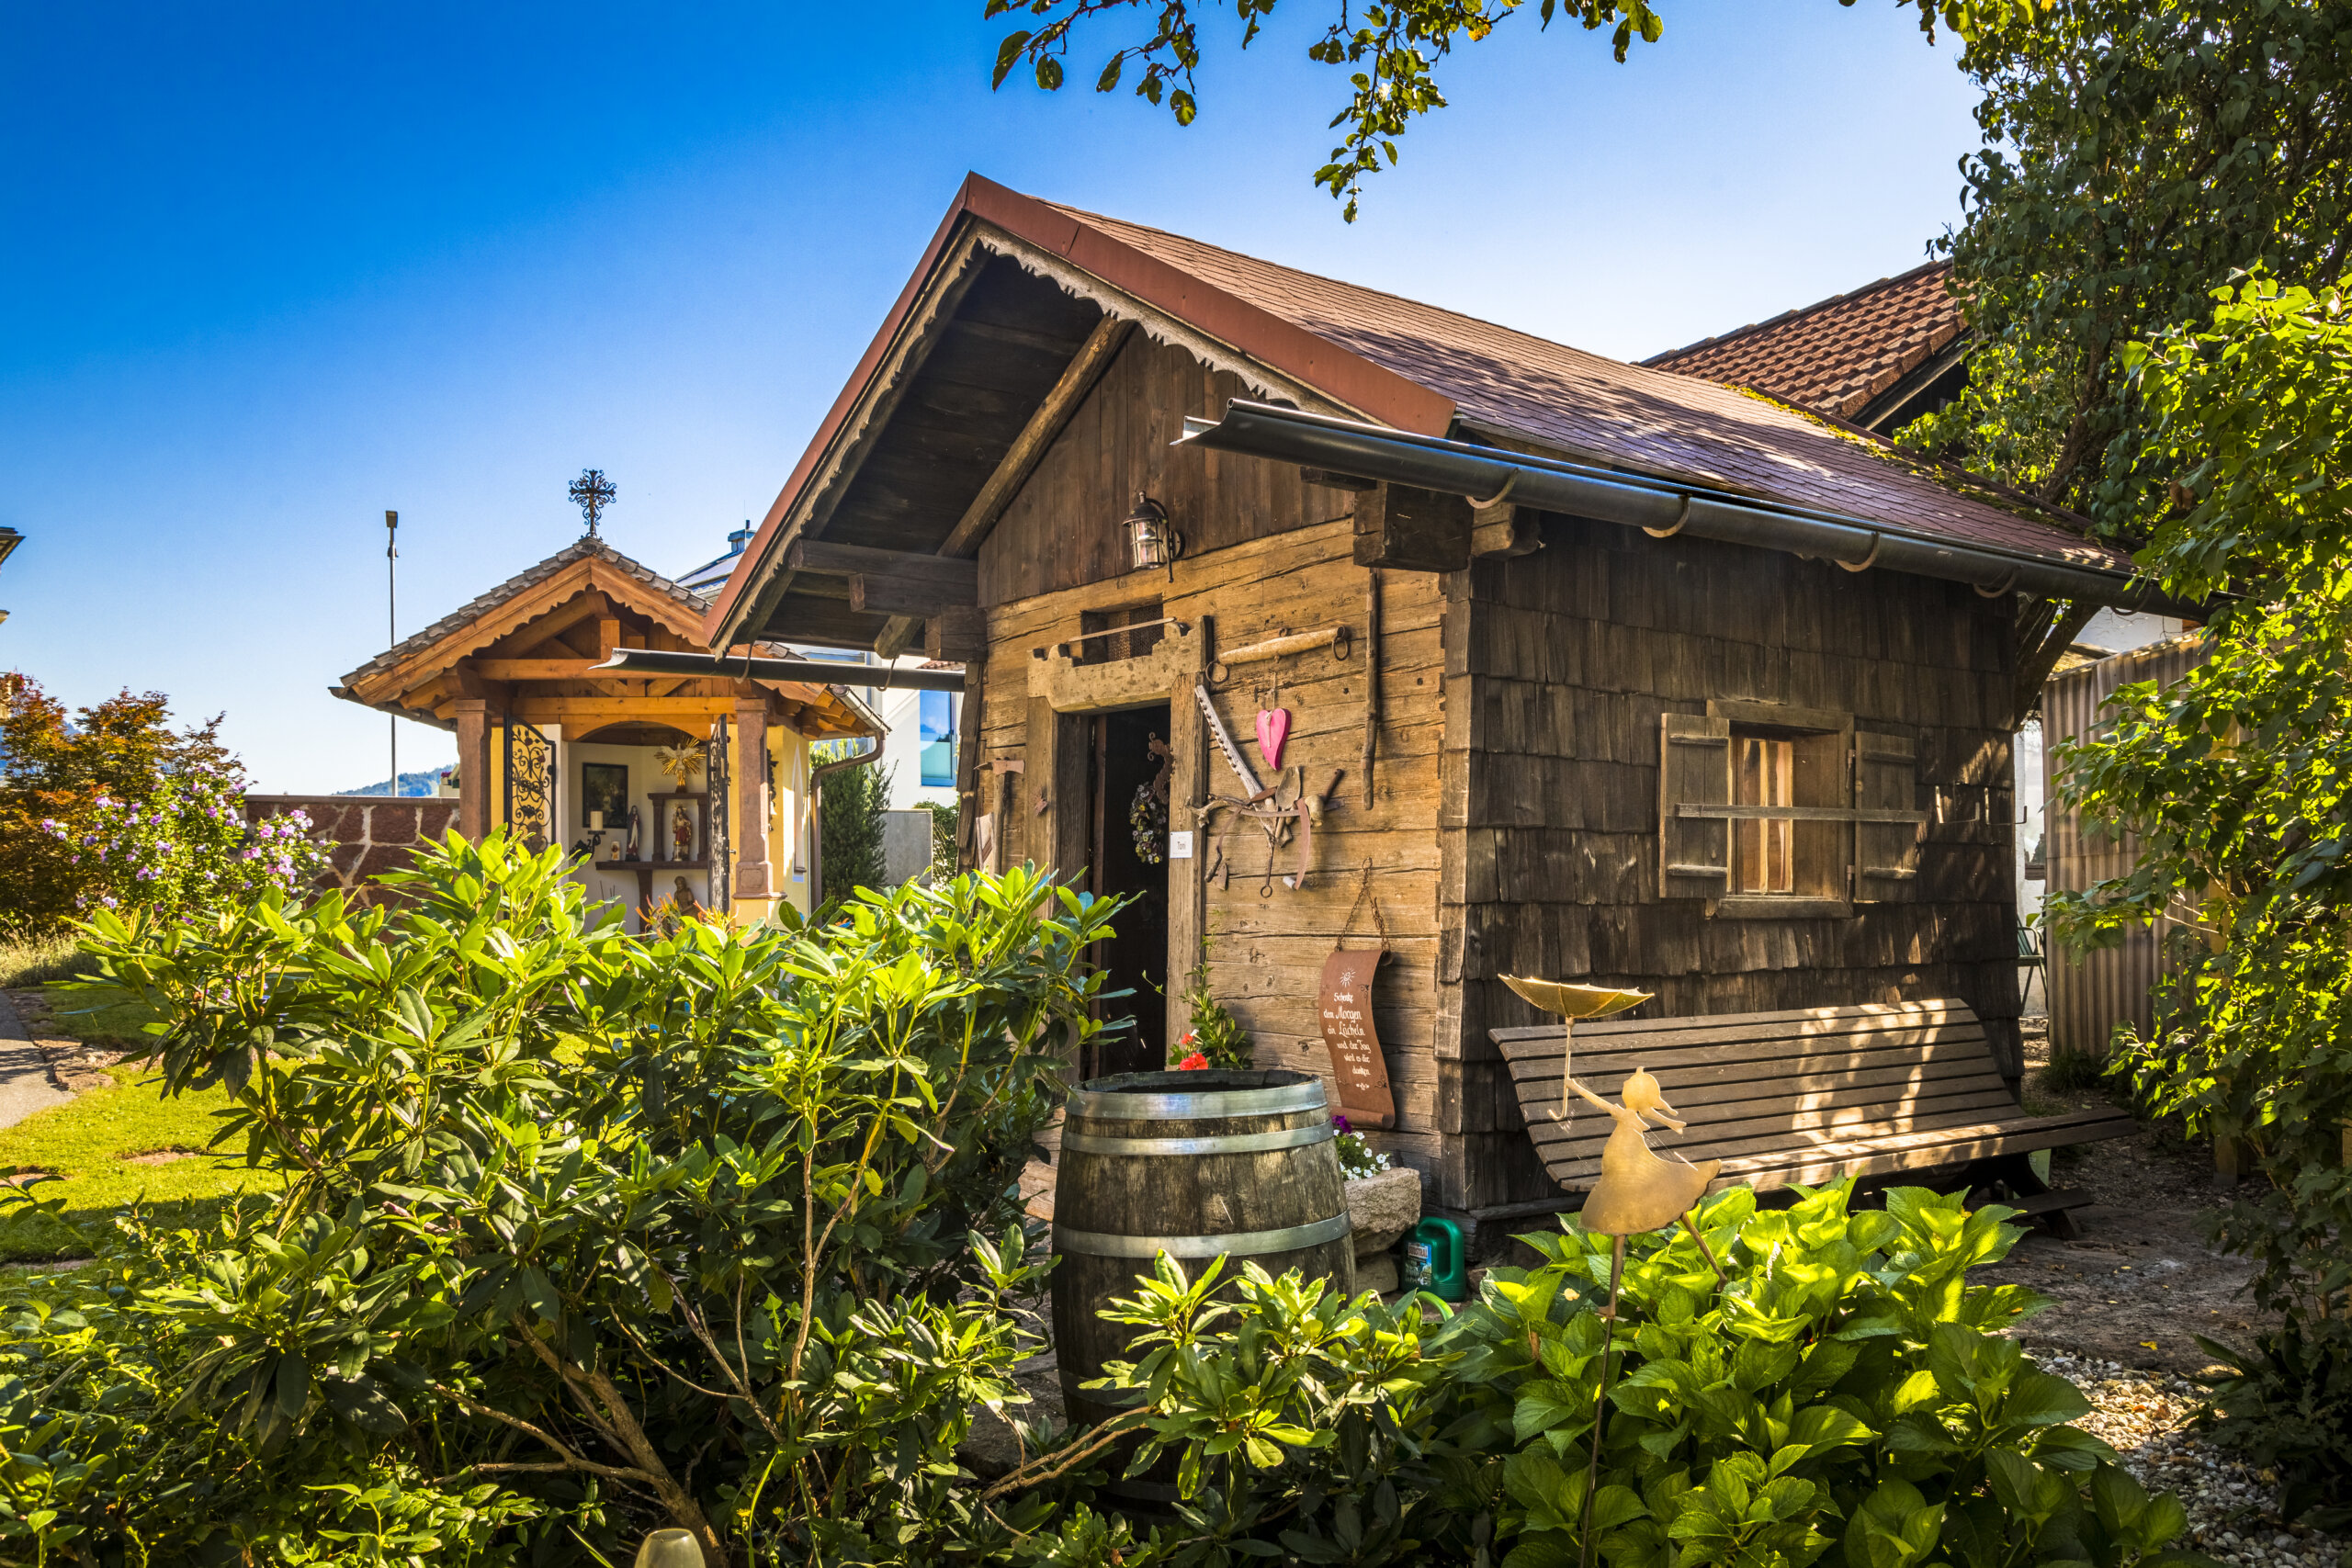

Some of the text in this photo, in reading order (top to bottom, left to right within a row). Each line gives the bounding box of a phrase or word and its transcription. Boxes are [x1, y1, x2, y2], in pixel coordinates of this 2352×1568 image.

[1334, 992, 1353, 1003] Schenke
[1324, 1006, 1363, 1023] dem Morgen
[1328, 1021, 1365, 1038] ein Lächeln
[1337, 1040, 1371, 1054] und der Tag
[1344, 1054, 1355, 1062] wird
[1352, 1066, 1371, 1077] danken
